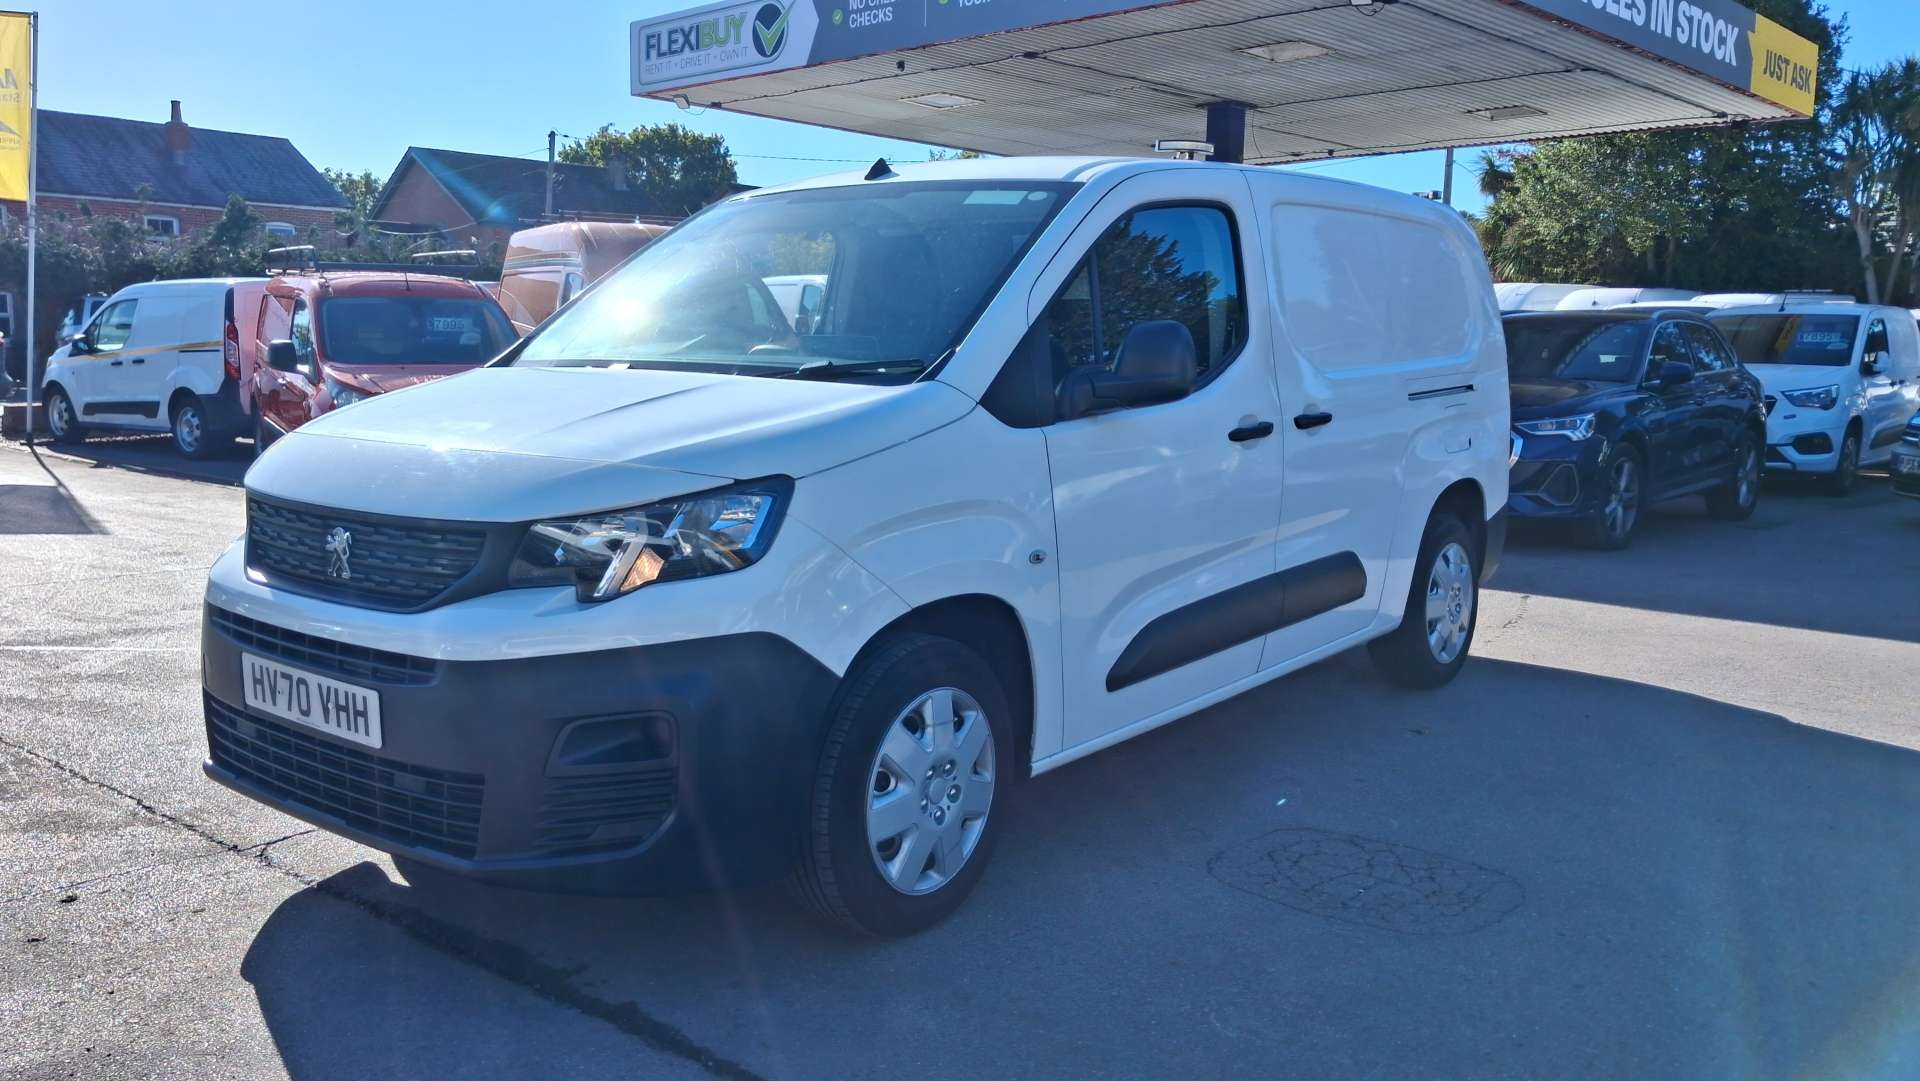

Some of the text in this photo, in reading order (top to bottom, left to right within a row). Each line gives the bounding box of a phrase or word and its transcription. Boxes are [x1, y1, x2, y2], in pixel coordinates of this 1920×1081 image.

[645, 12, 748, 62] FLEXIBUY
[849, 7, 894, 29] CHECKS
[1650, 0, 1675, 38] IN
[1676, 0, 1740, 67] STOCK
[680, 54, 702, 70] DRIVE
[704, 53, 712, 65] IT
[719, 48, 740, 62] OWN
[741, 46, 749, 57] IT
[1762, 48, 1813, 95] JUST ASK
[251, 661, 371, 737] HV70 VHH
